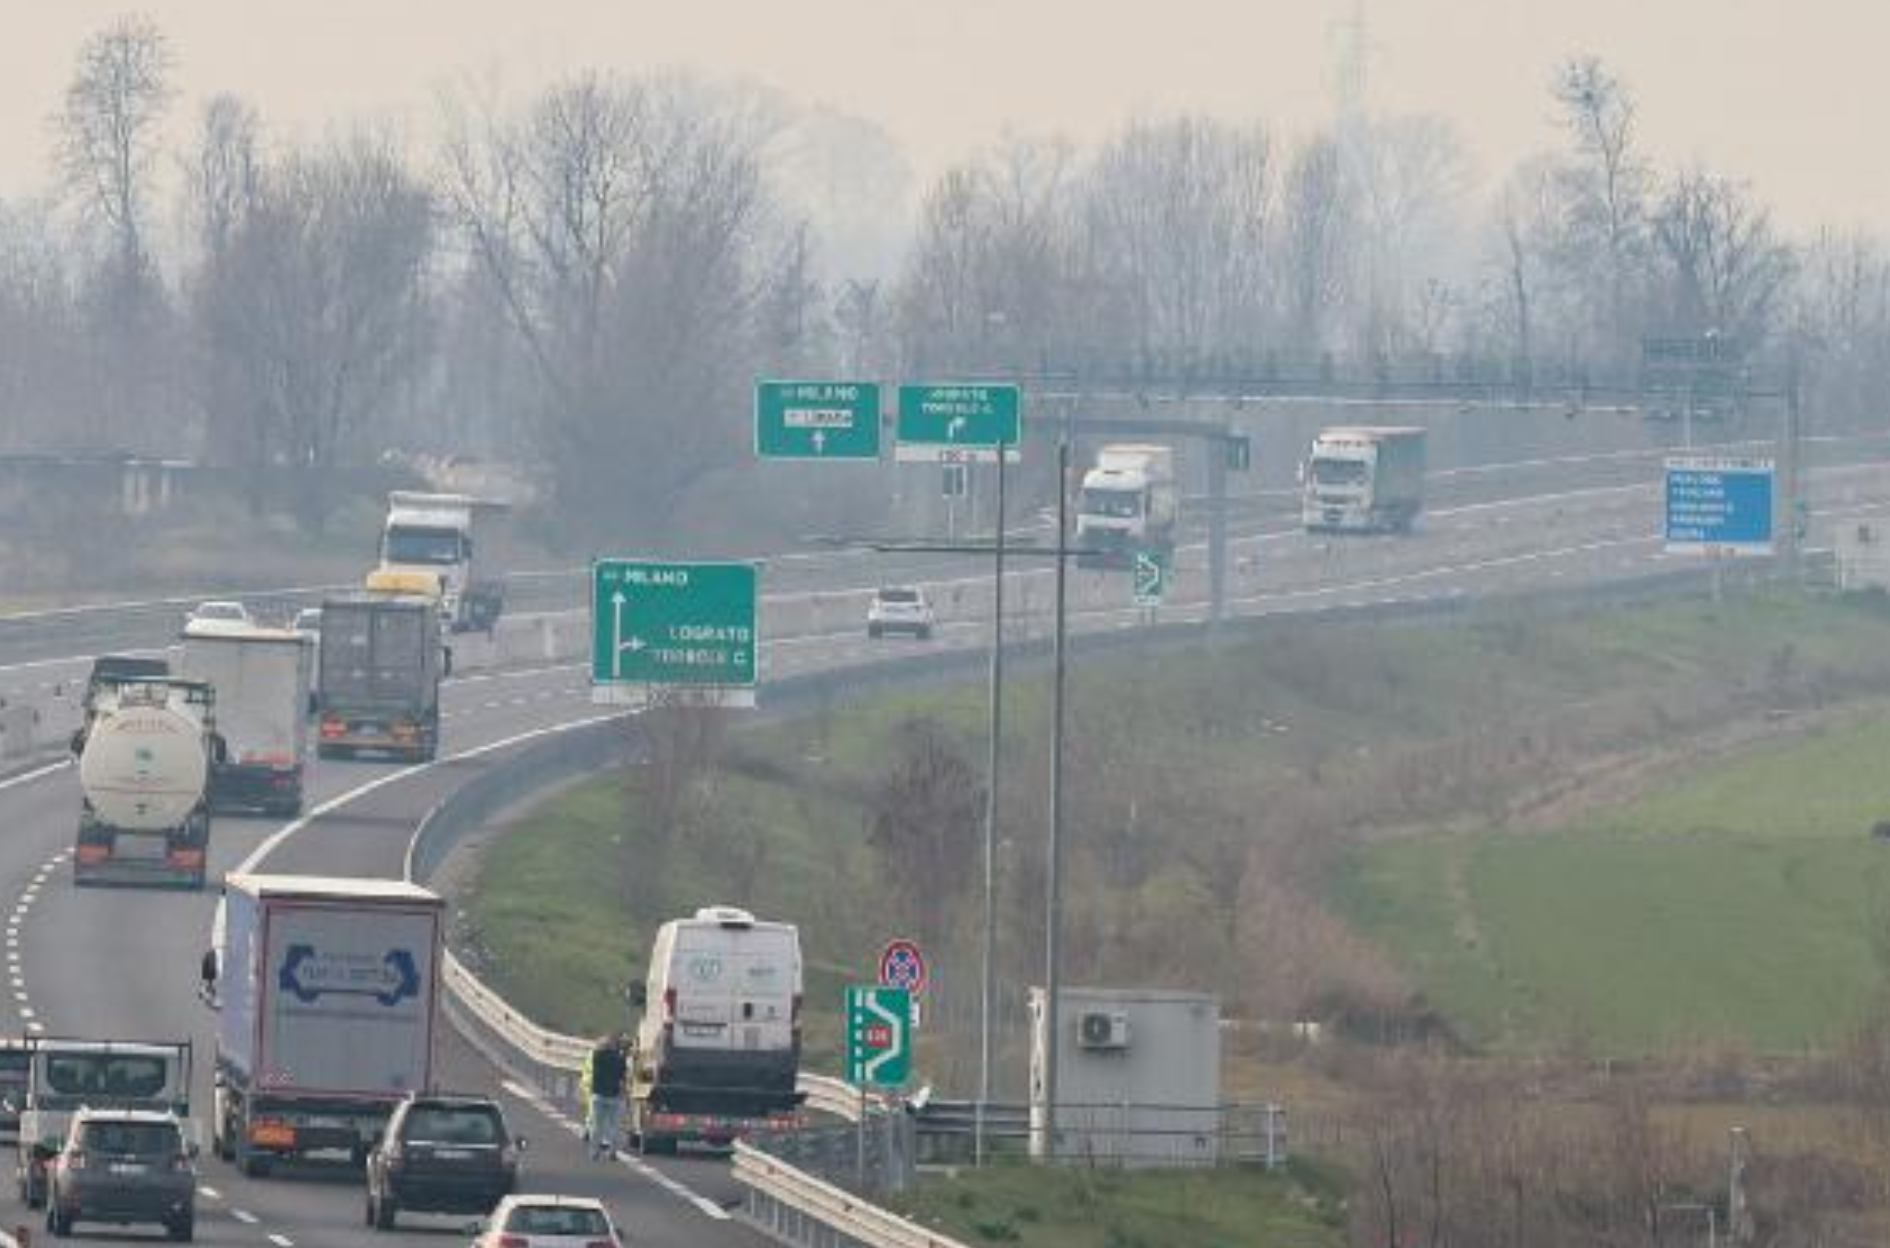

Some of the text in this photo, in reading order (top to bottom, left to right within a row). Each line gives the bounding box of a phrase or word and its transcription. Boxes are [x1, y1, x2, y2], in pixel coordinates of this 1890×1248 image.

[797, 386, 859, 401] MILANO
[624, 569, 689, 584] MILANO
[669, 625, 750, 642] LOGRATO
